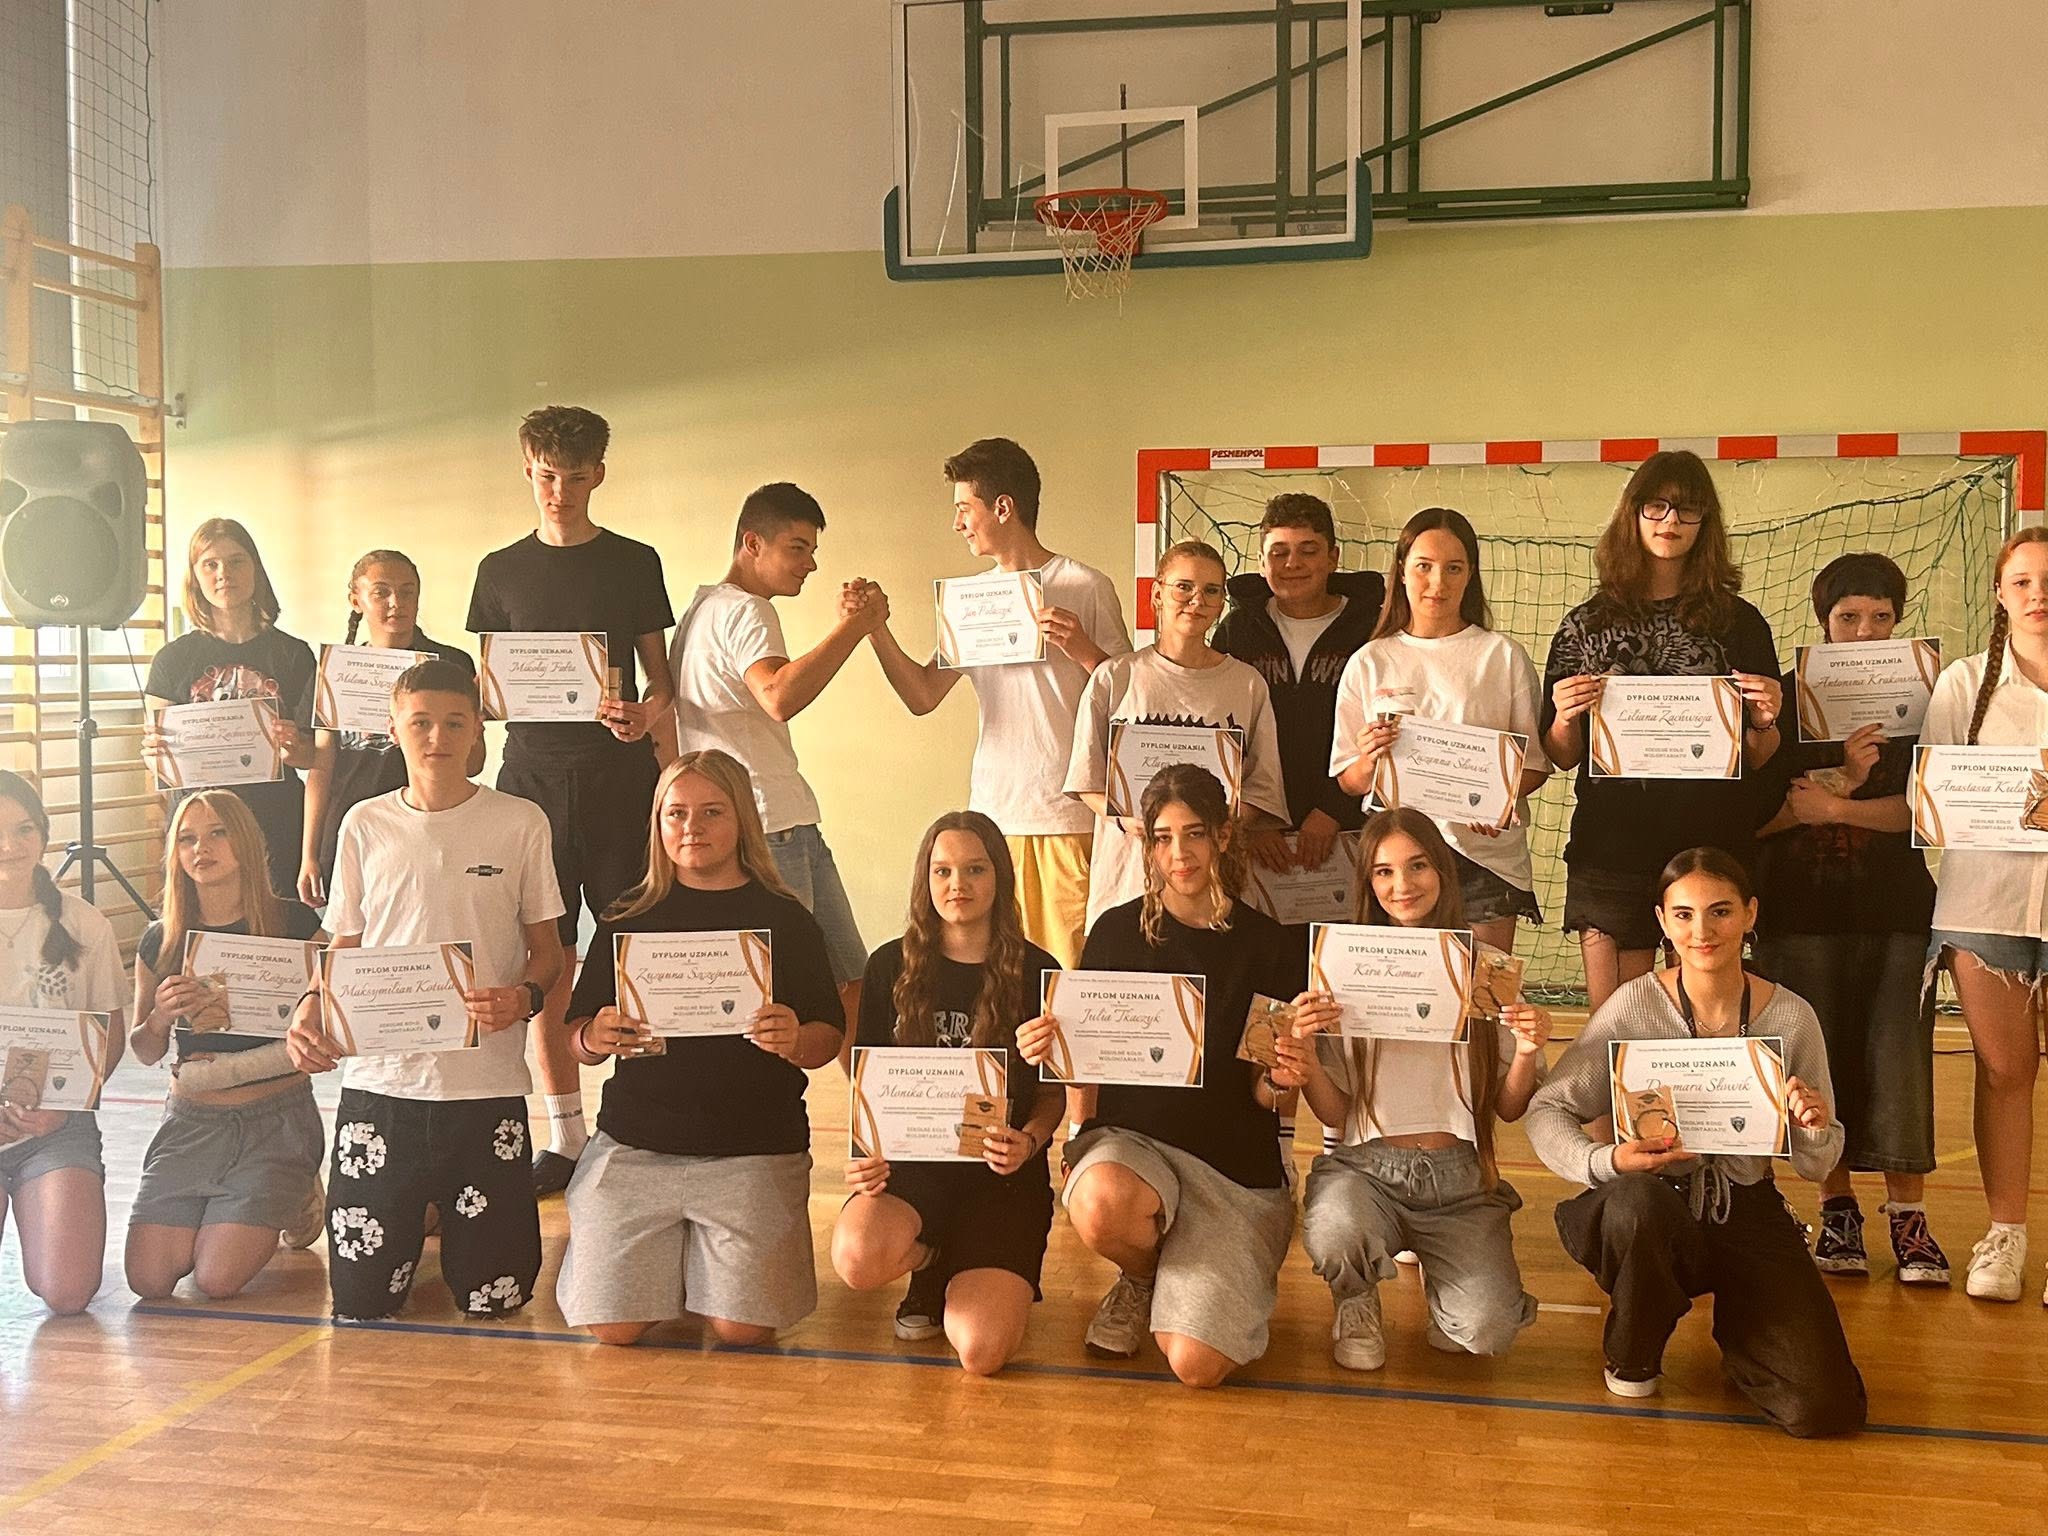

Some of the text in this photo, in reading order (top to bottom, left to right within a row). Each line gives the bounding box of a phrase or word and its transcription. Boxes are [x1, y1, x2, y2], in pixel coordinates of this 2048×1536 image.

[1812, 676, 1864, 688] Antonina
[1617, 709, 1657, 722] Liliana
[1416, 735, 1486, 752] DYPLOM UZNANIA
[1407, 749, 1452, 766] Zuzanna
[1933, 780, 1991, 792] Anastasia
[1348, 945, 1427, 956] DYPLOM UZNANIA
[220, 952, 292, 964] DYPLOM UZNANIA
[355, 964, 432, 974] DYPLOM UZNANIA
[635, 967, 684, 985] Zuzanna
[339, 983, 412, 1002] Maksymilian
[1080, 1008, 1164, 1029] Julia Tkaczyk
[28, 1027, 67, 1035] UZNANIA
[878, 1084, 923, 1098] Monika
[1646, 1078, 1702, 1092] Dmara
